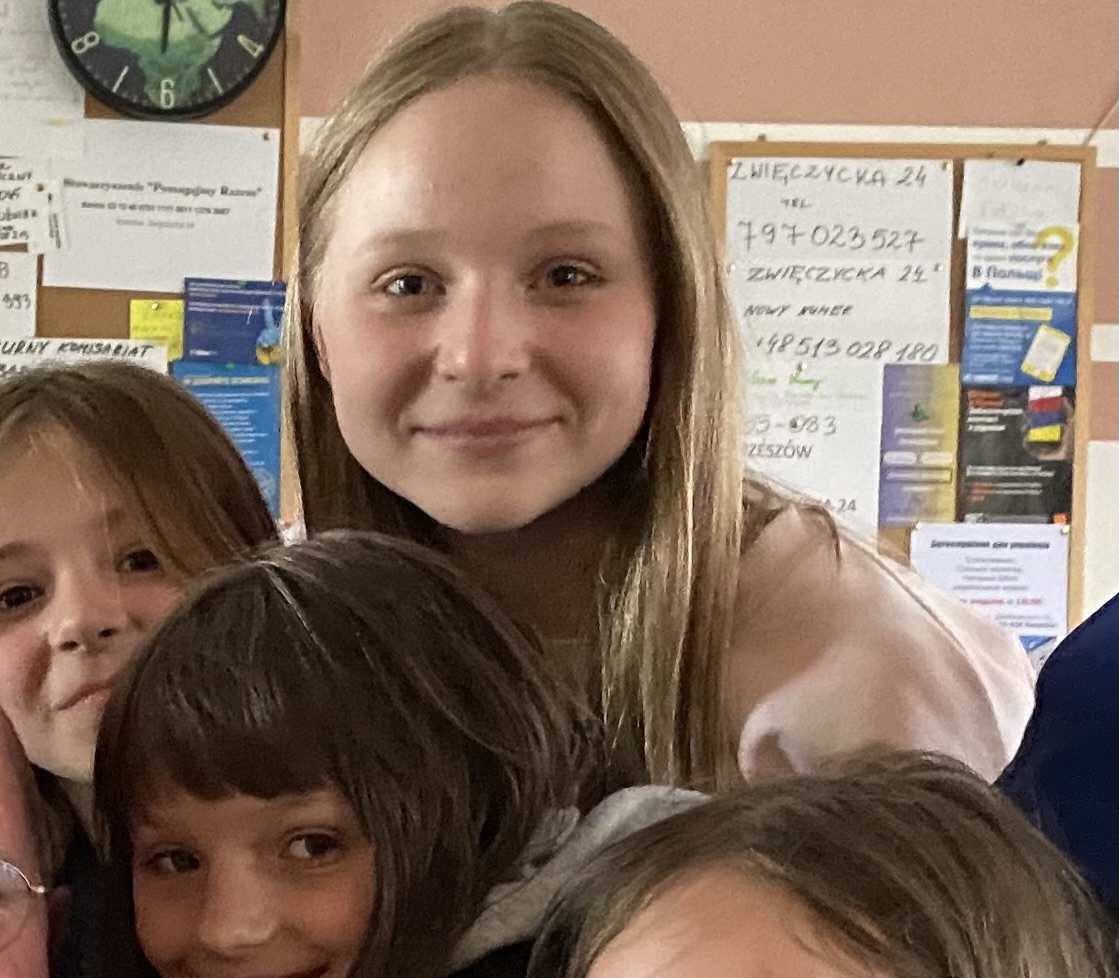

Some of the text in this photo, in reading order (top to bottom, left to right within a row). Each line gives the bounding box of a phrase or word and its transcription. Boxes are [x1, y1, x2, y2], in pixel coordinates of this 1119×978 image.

[71, 31, 100, 54] 8
[237, 34, 265, 58] 4
[160, 78, 175, 110] 6
[896, 165, 927, 188] 24
[737, 220, 924, 253] 797 023 527
[743, 304, 792, 318] NOWY
[796, 336, 841, 358] 513
[845, 340, 892, 360] 028
[895, 343, 940, 363] 180
[746, 439, 813, 460] ZESZÓW
